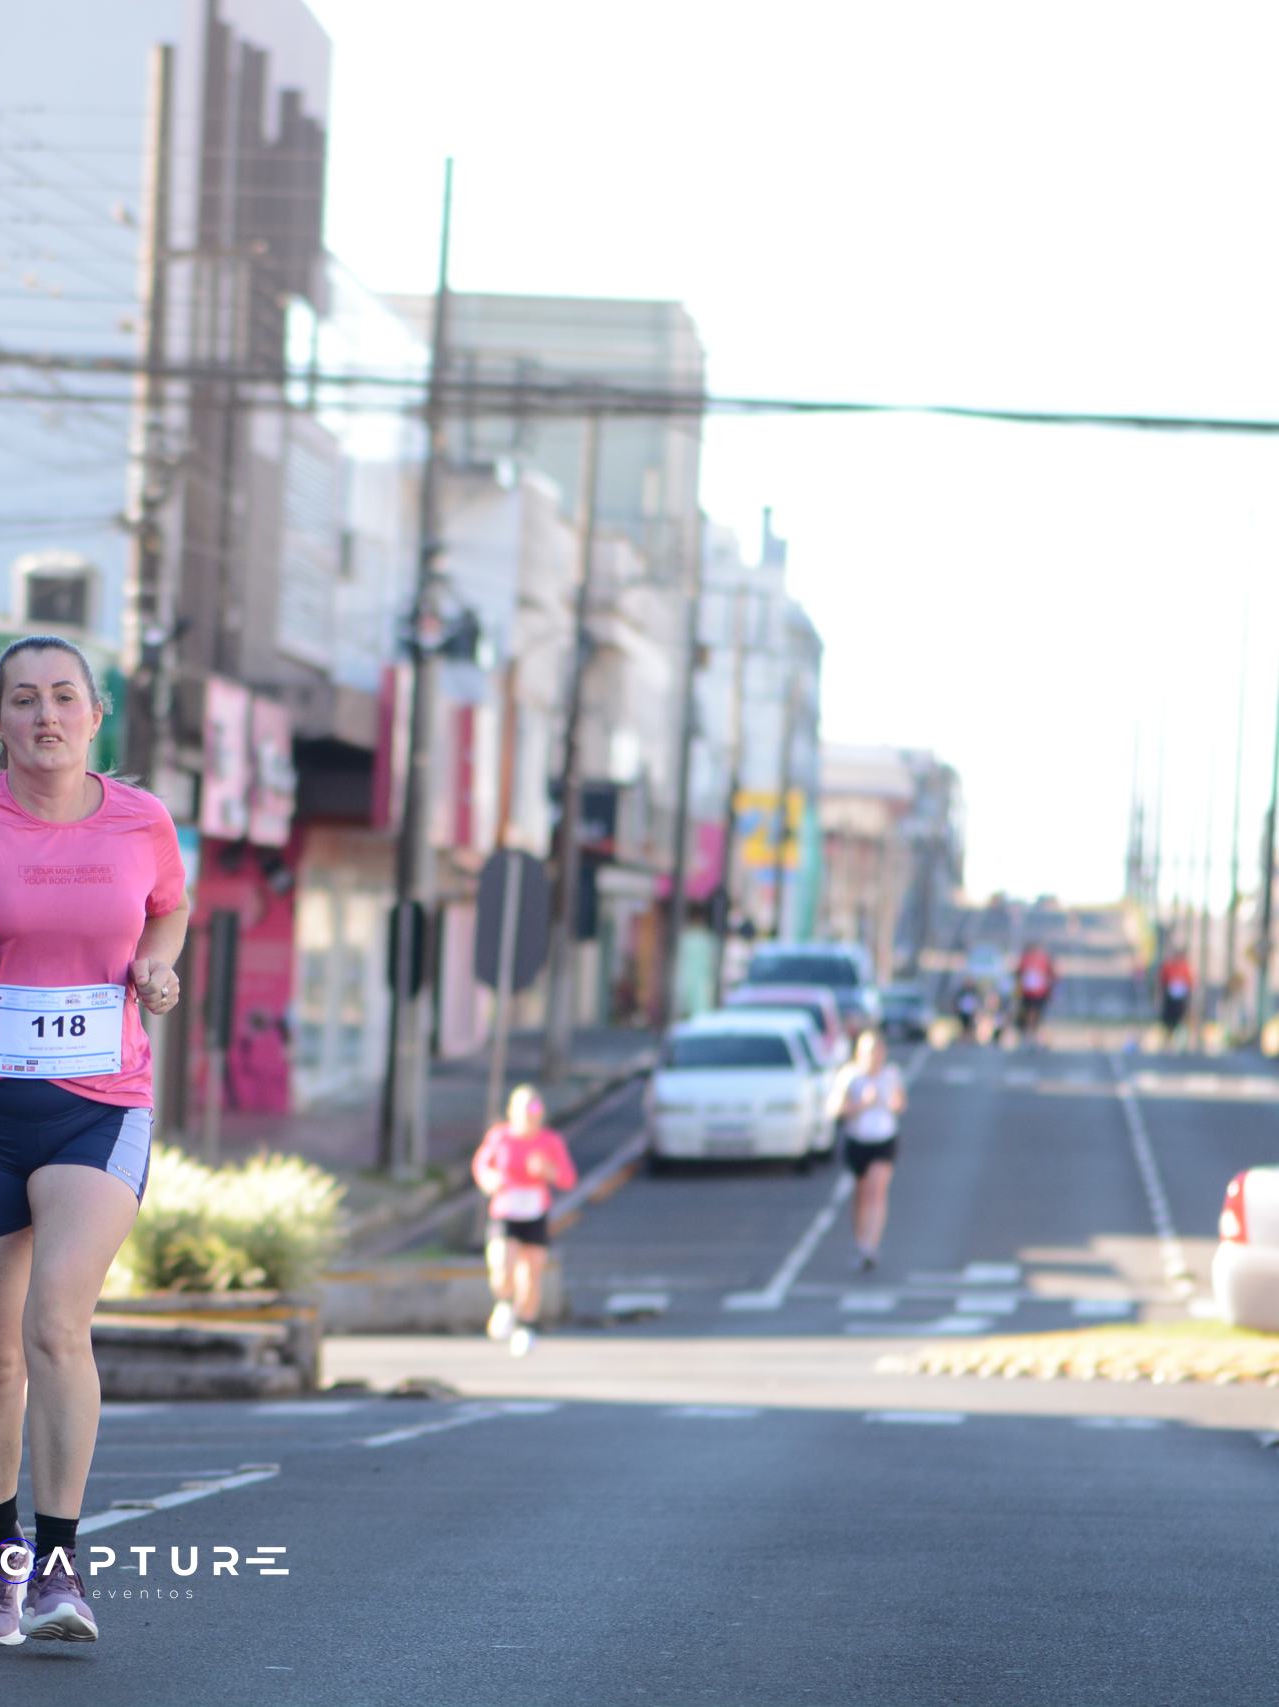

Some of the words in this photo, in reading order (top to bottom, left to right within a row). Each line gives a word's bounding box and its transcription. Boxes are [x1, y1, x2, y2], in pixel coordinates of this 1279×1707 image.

[33, 867, 54, 875] YOUR
[56, 867, 75, 875] MIND
[76, 866, 111, 874] BELIEVES
[24, 877, 47, 885] YOUR
[49, 877, 72, 885] BODY
[74, 876, 113, 884] ACHIEVES
[31, 1014, 86, 1038] 118
